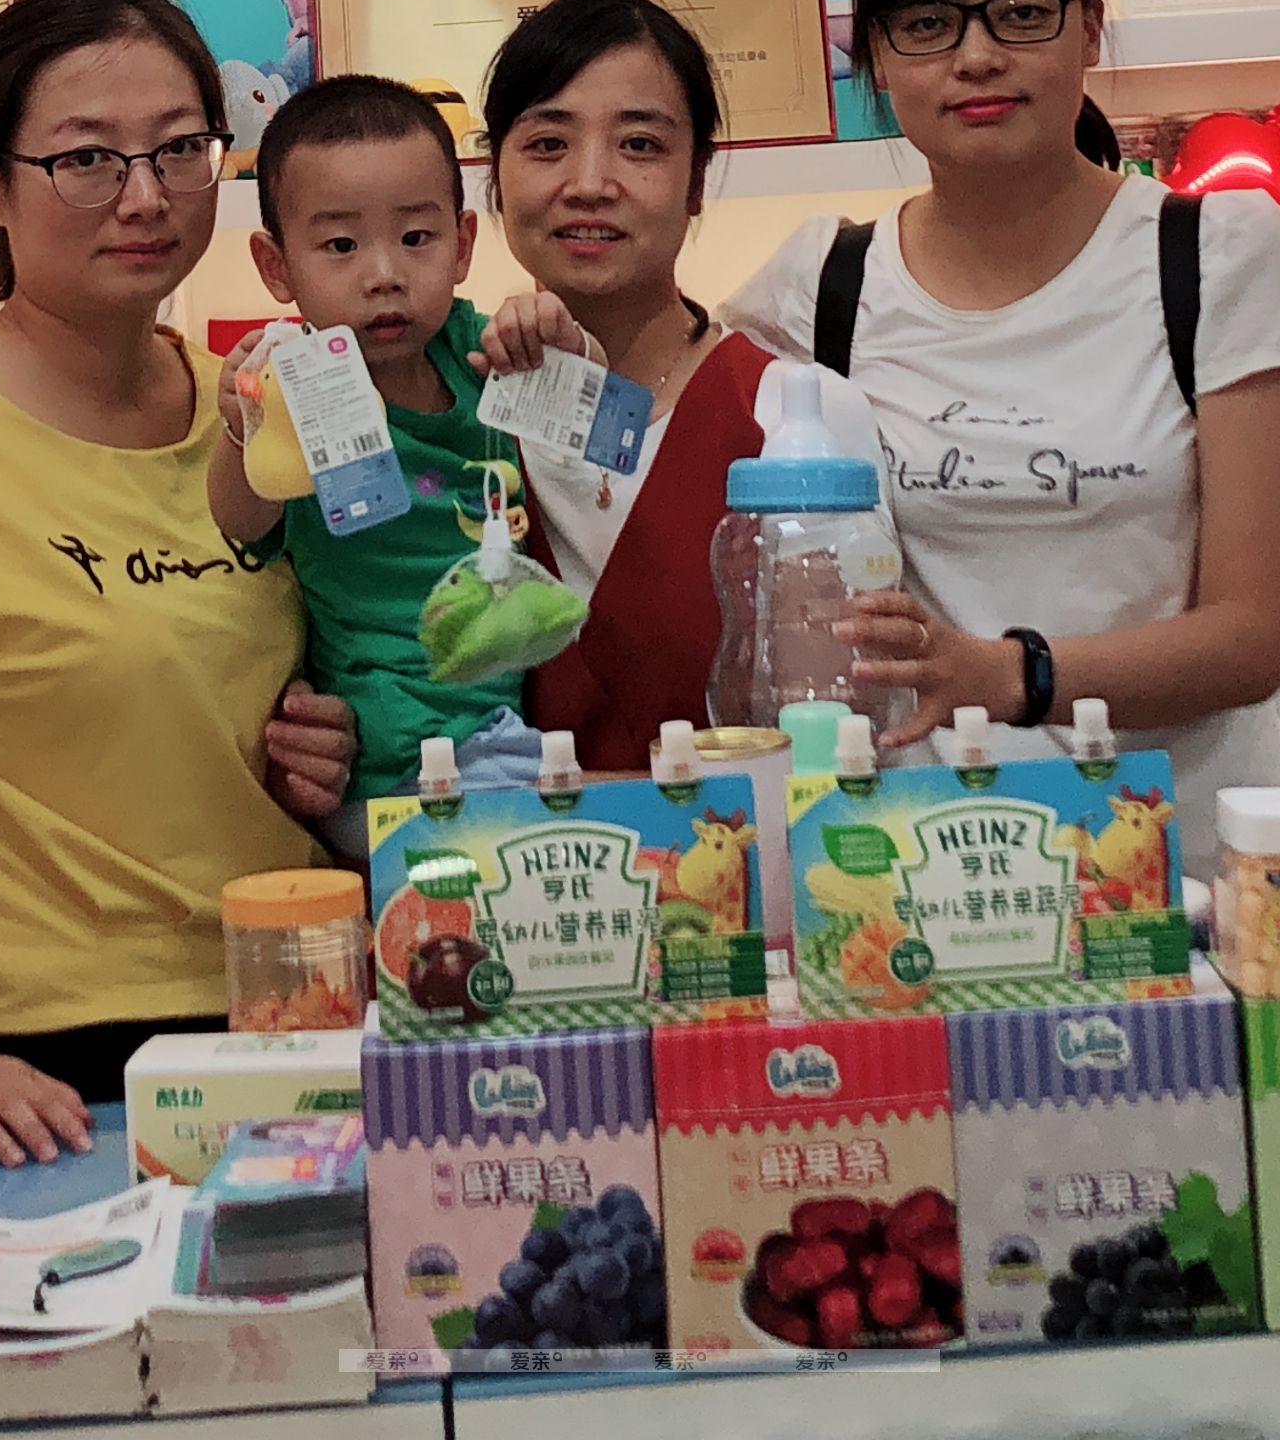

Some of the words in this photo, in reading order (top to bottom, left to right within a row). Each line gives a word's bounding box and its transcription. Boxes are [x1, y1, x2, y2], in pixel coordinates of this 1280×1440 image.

[937, 817, 1029, 852] HEINZ
[521, 841, 612, 877] HEINZ
[540, 875, 594, 903] 亨氏
[462, 1155, 593, 1209] 鲜果条
[759, 1138, 889, 1190] 鲜果条
